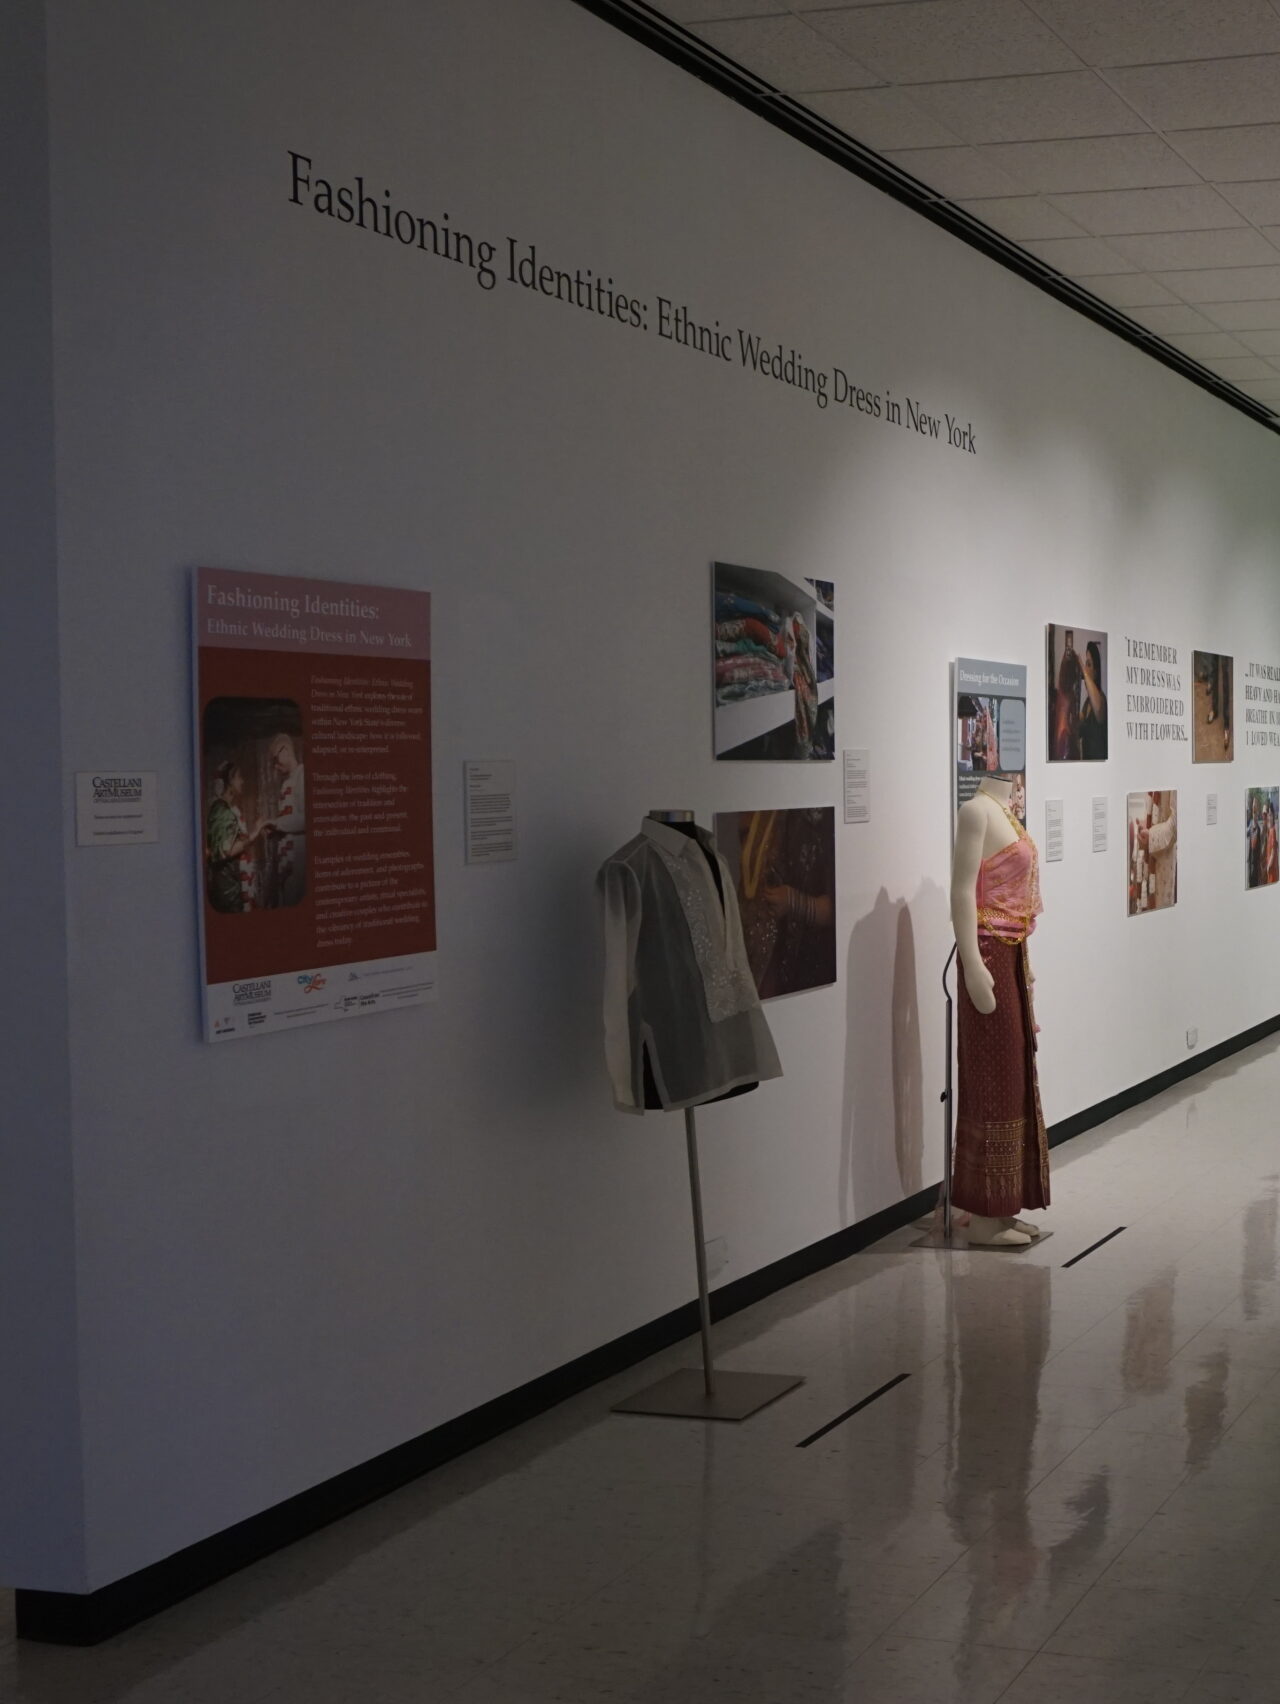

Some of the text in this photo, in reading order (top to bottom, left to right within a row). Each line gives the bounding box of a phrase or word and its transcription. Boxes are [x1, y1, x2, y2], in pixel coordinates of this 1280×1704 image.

[287, 151, 977, 454] Fashioning Identities: Ethnic Wedding Dress in New York
[208, 585, 379, 620] Fashioning Identities:
[208, 618, 412, 647] Ethnic Wedding Dress in New York
[1133, 640, 1177, 664] REMEMBER
[1126, 666, 1181, 691] MY DRESS WAS
[1127, 695, 1184, 716] EMBROIDERED
[1127, 722, 1148, 740] WITH
